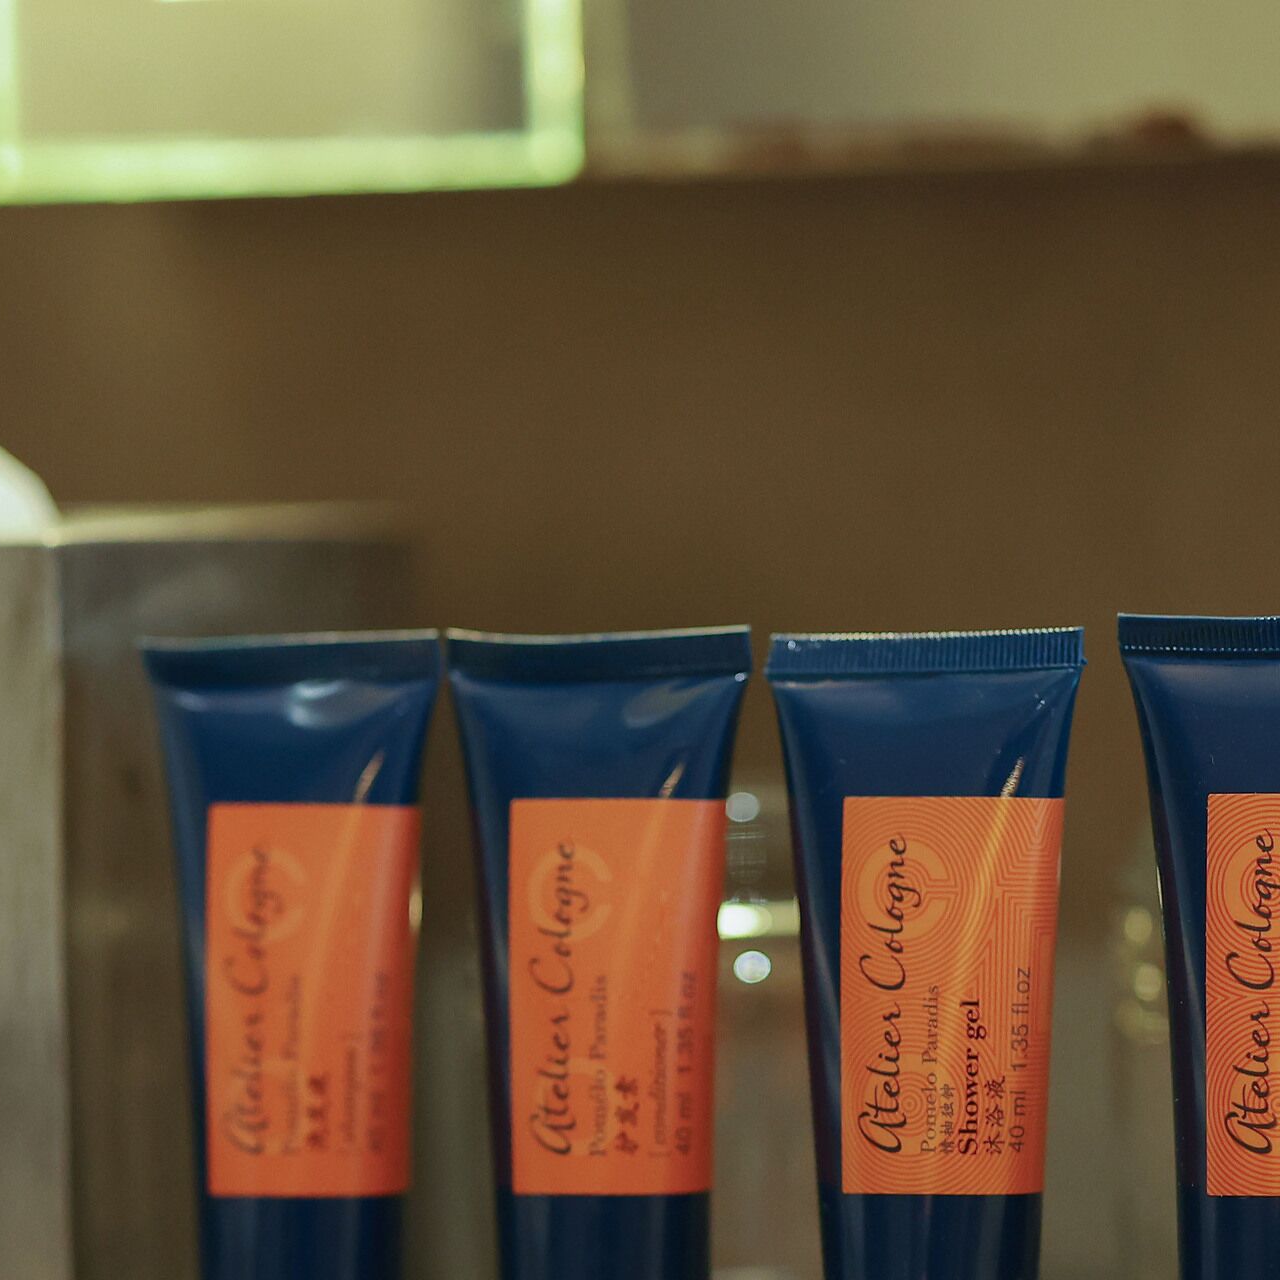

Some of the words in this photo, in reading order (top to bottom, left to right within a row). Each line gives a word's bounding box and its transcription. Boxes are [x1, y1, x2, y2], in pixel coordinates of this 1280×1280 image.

[222, 846, 284, 995] Cologne
[527, 839, 589, 995] Cologne
[859, 835, 921, 990] Cologne
[589, 975, 608, 1060] Paradis
[921, 986, 940, 1065] Paradis
[960, 999, 986, 1040] gel
[1011, 967, 1032, 1015] fl.oz
[529, 1010, 577, 1156] Atelier
[858, 1004, 907, 1154] Atelier
[1011, 1024, 1029, 1071] 1.35
[1224, 1000, 1276, 1155] Atelier
[676, 1128, 692, 1155] 40
[920, 1072, 938, 1154] Pomelo
[957, 1048, 980, 1155] Shower
[984, 1075, 1006, 1155] 沐浴液
[1009, 1090, 1027, 1117] ml
[1009, 1125, 1026, 1152] 40
